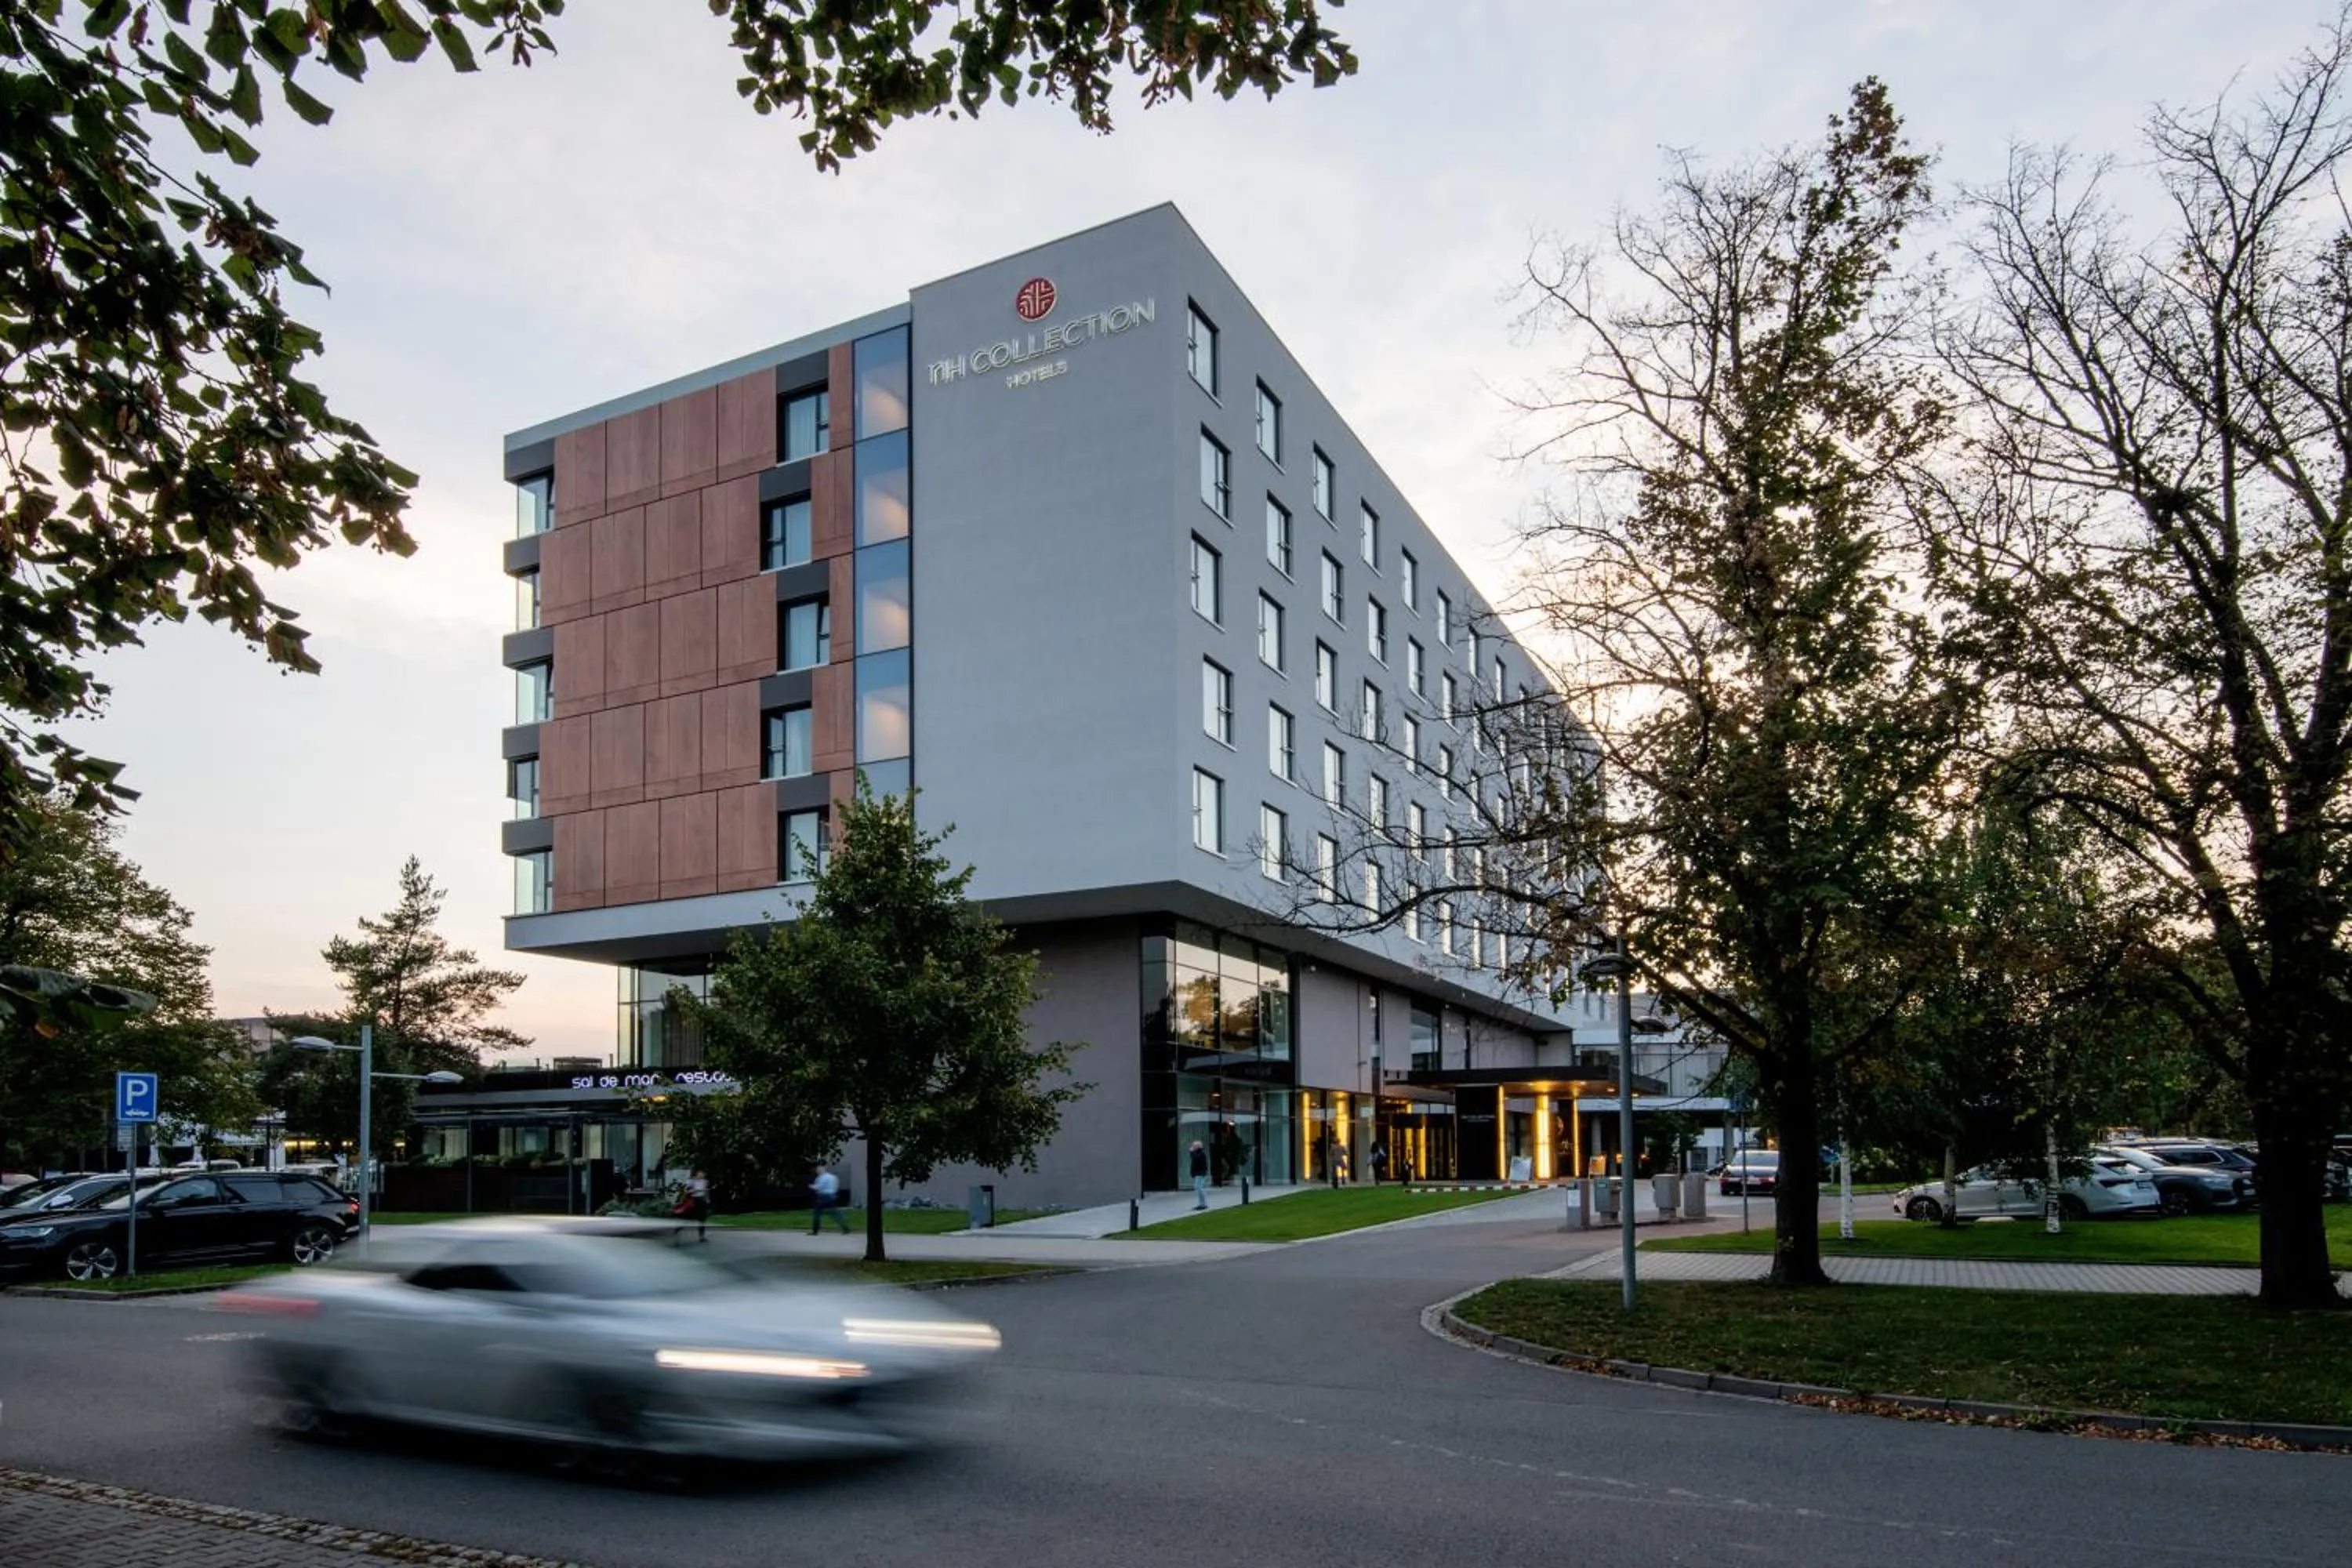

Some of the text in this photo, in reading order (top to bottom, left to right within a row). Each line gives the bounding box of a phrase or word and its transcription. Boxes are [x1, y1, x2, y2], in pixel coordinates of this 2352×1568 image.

[971, 296, 1156, 375] COLLECTION
[1006, 361, 1069, 388] HOTELS
[127, 1080, 148, 1105] P
[572, 1077, 593, 1089] sal
[599, 1074, 619, 1088] de
